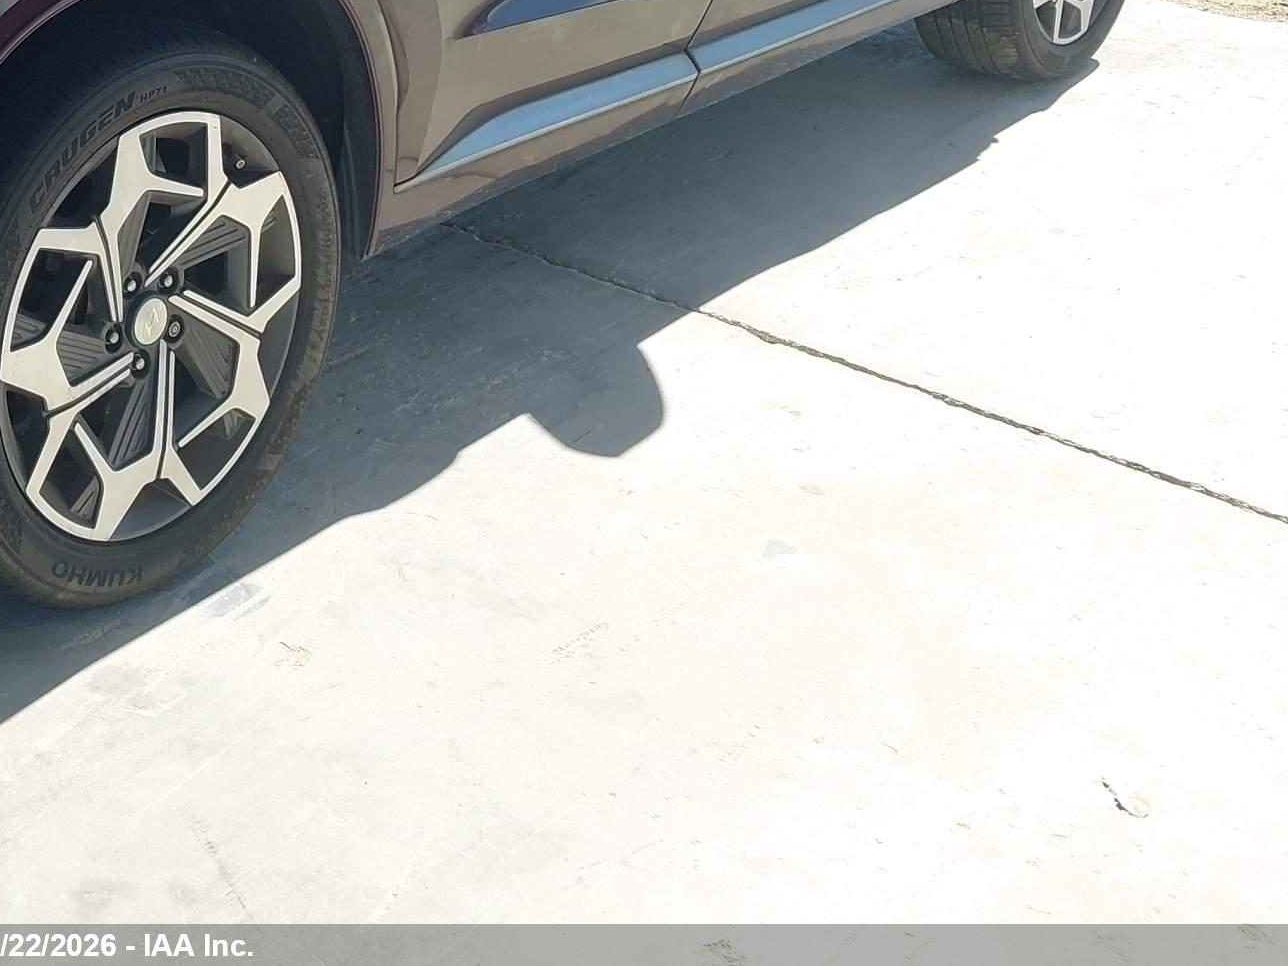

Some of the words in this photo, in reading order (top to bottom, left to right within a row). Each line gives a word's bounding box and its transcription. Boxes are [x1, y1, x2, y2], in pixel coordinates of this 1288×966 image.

[29, 91, 136, 213] CRUGEN
[139, 85, 168, 104] HP71
[52, 561, 143, 587] KUMHO
